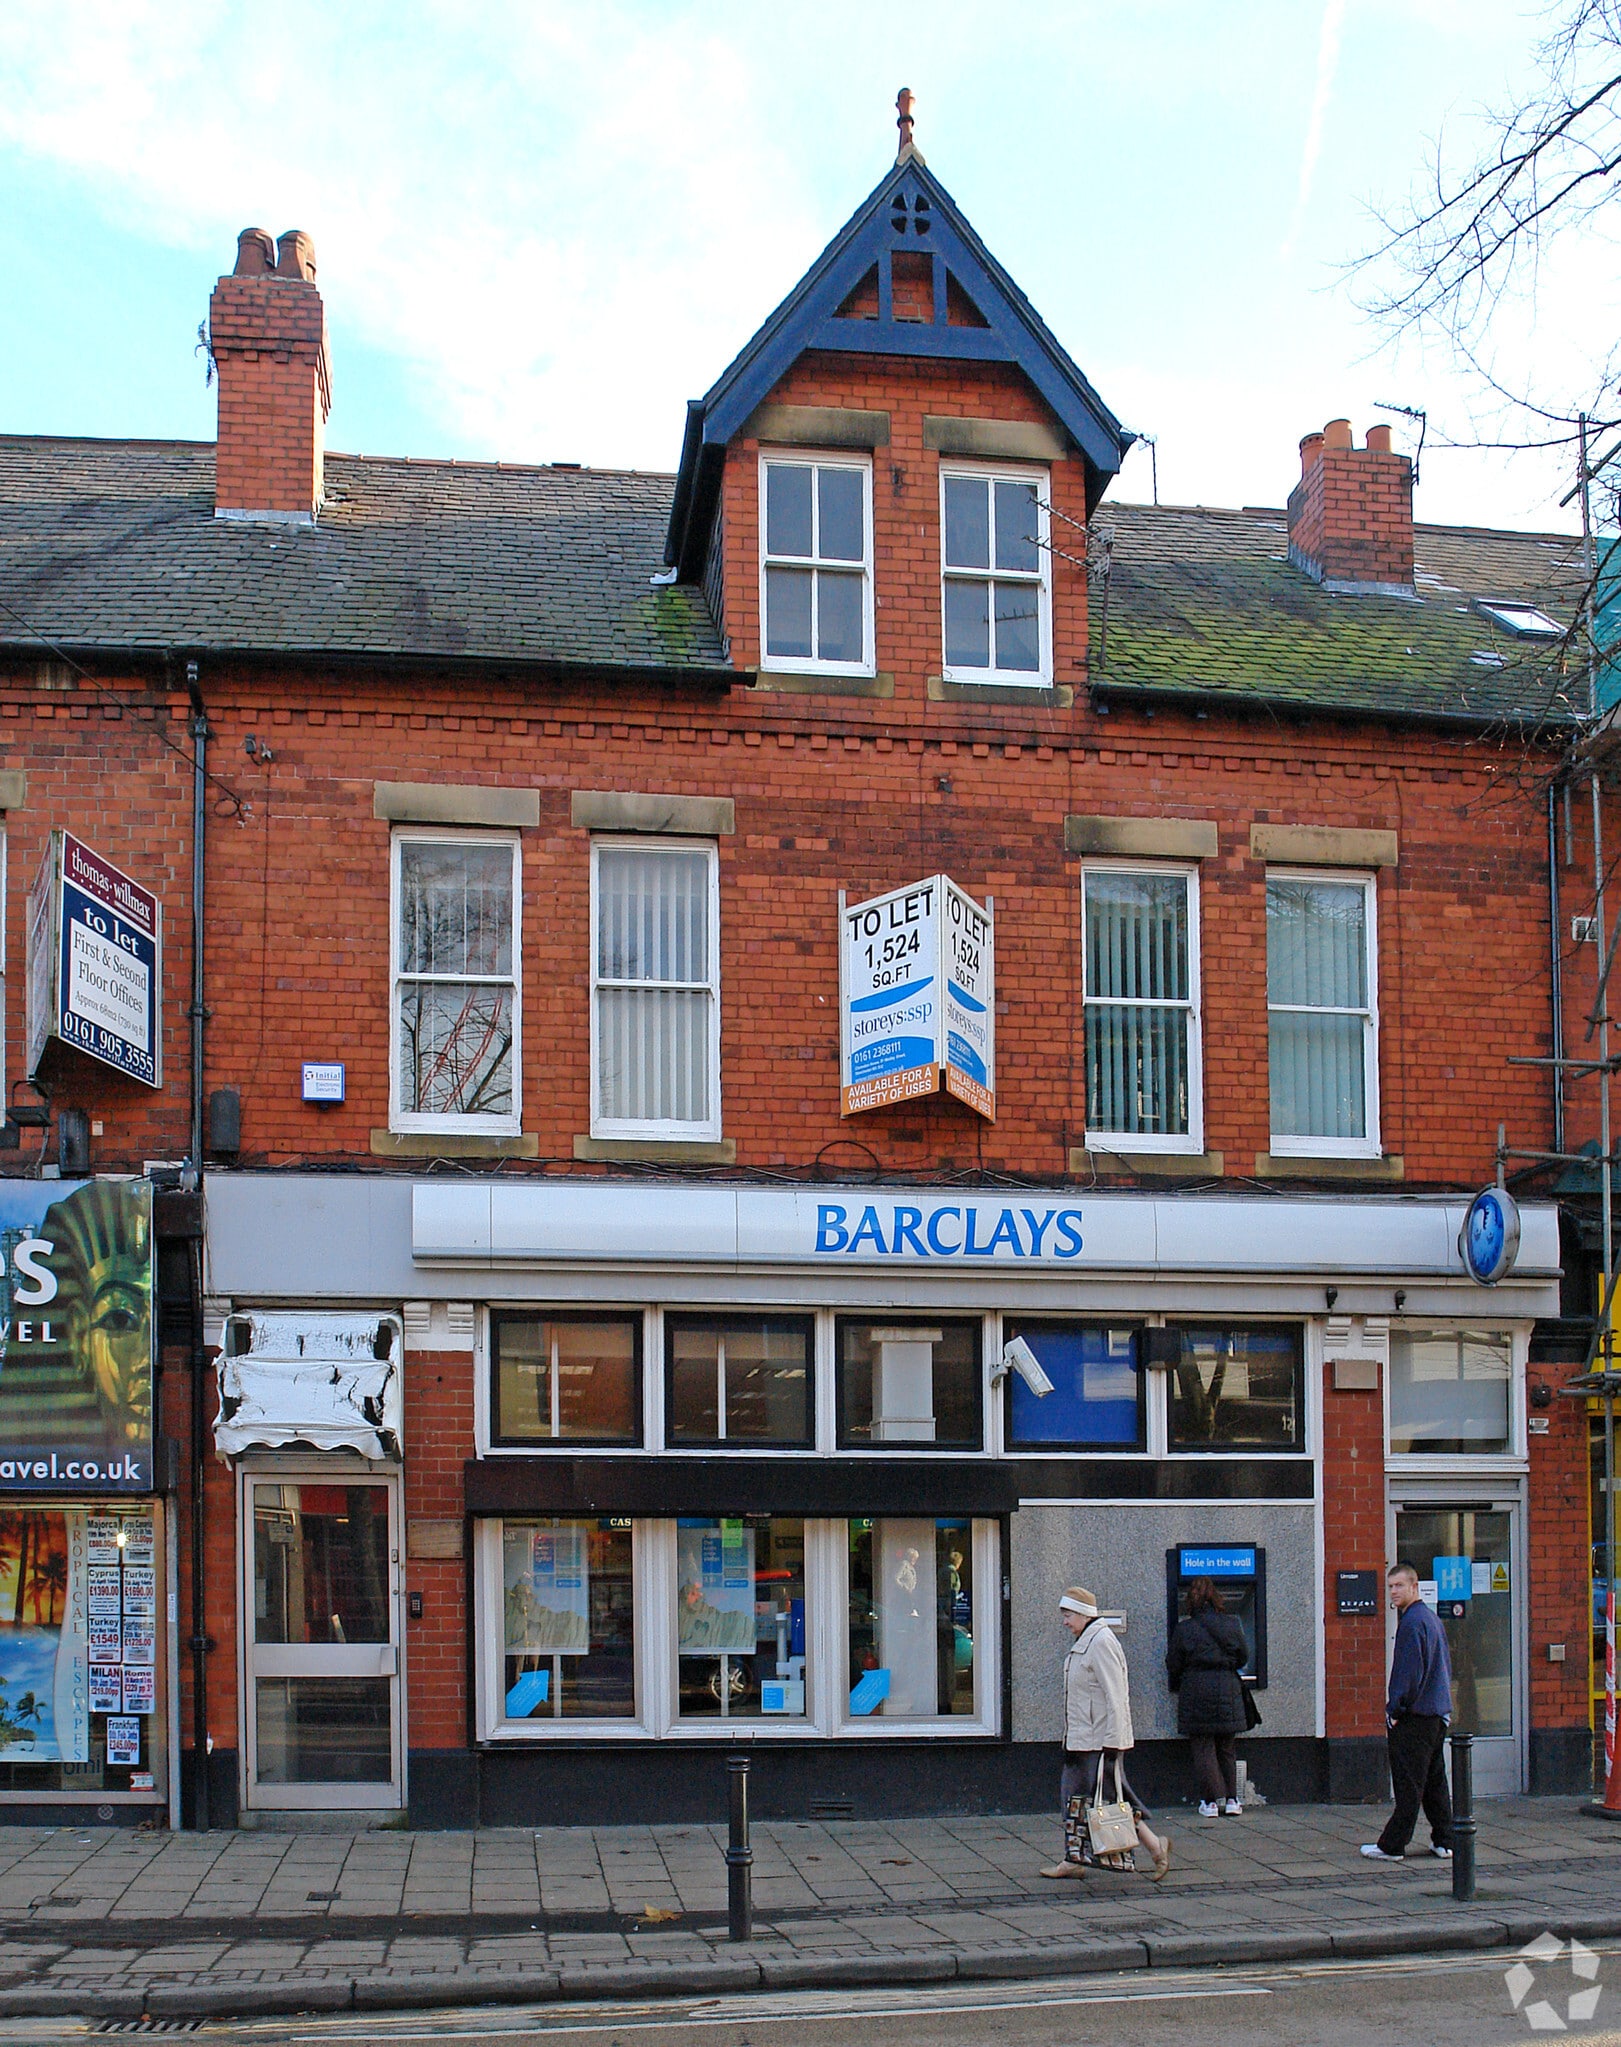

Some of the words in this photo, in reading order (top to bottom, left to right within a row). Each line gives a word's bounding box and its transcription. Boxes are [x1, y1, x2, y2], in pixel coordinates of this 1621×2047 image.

[72, 848, 109, 892] thomas
[113, 882, 150, 921] willmax
[84, 907, 107, 934] to
[113, 919, 139, 956] let
[849, 909, 881, 942] TO
[890, 888, 934, 929] LET
[965, 906, 988, 947] LET
[74, 930, 99, 961] First
[102, 948, 112, 968] &
[113, 954, 146, 991] Second
[865, 929, 921, 970] 1,524
[952, 931, 980, 974] 1,524
[79, 960, 108, 993] Floor
[110, 979, 143, 1014] Offices
[872, 963, 913, 989] SQ.FT
[955, 965, 975, 992] SQ.FT
[75, 991, 99, 1013] Approx
[853, 1001, 933, 1038] storeys:ssp
[64, 1011, 95, 1044] 0161
[99, 1030, 122, 1057] 905
[125, 1044, 153, 1074] 3555
[854, 1049, 871, 1064] 0161
[873, 1041, 901, 1058] 2368111
[848, 1075, 900, 1099] AVAILABLE
[902, 1069, 922, 1085] FOR
[924, 1066, 932, 1079] A
[848, 1091, 888, 1111] VARIETY
[890, 1086, 903, 1100] OF
[906, 1079, 932, 1096] USES
[949, 1067, 976, 1094] AVAILABLE
[976, 1084, 986, 1100] FOR
[986, 1093, 991, 1103] A
[950, 1079, 971, 1102] VARIETY
[970, 1094, 978, 1107] OF
[978, 1099, 991, 1116] USES
[815, 1205, 1083, 1257] BARCLAYS
[0, 1239, 57, 1305] S
[0, 1453, 140, 1480] avel.co.uk
[88, 1519, 118, 1530] Majorca
[72, 1514, 83, 1635] TROPICAL
[89, 1569, 119, 1578] Cyprus
[124, 1571, 154, 1580] Turkey
[1185, 1558, 1205, 1568] Hole
[1206, 1558, 1215, 1567] in
[1216, 1557, 1231, 1567] the
[1232, 1557, 1251, 1567] wall
[1441, 1567, 1464, 1590] Hi
[90, 1618, 119, 1627] Turkey
[91, 1634, 119, 1644] £1549
[91, 1667, 120, 1677] MILAN
[73, 1656, 84, 1761] ESCAPES
[108, 1719, 139, 1730] Frankfurt
